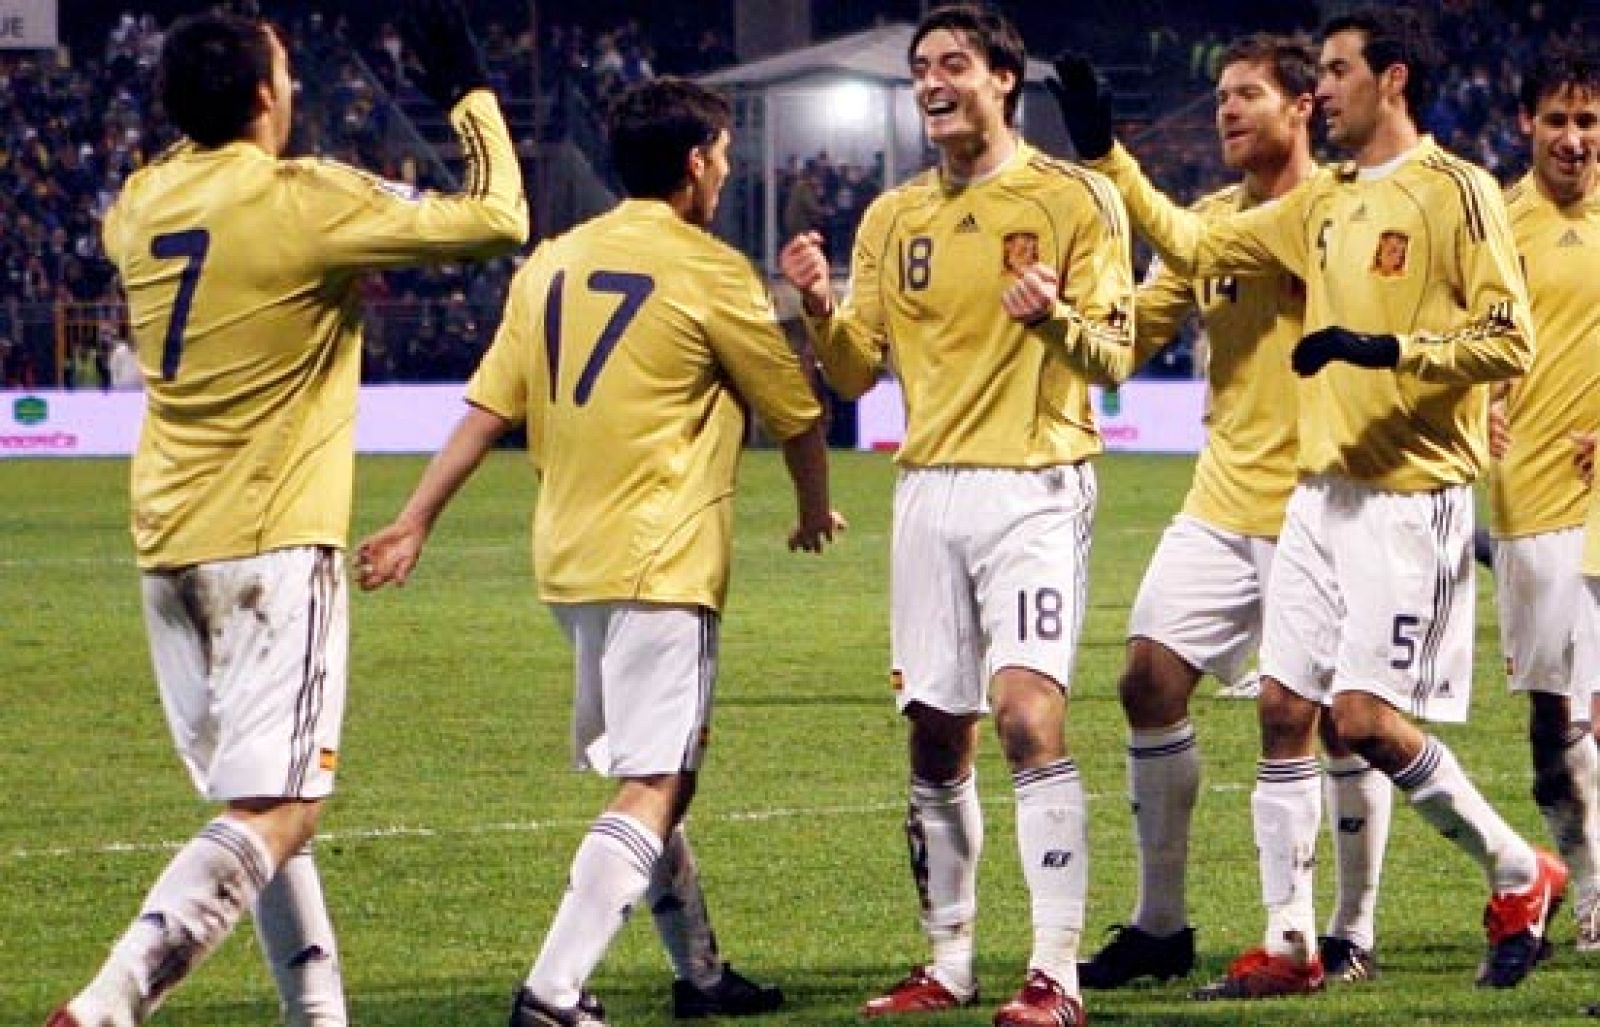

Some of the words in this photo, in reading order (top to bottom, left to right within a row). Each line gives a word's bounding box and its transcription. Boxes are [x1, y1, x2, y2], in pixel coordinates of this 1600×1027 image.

[898, 235, 934, 293] 18
[150, 228, 210, 382] 7
[543, 268, 656, 406] 17
[1017, 587, 1063, 643] 18
[1391, 613, 1420, 670] 5
